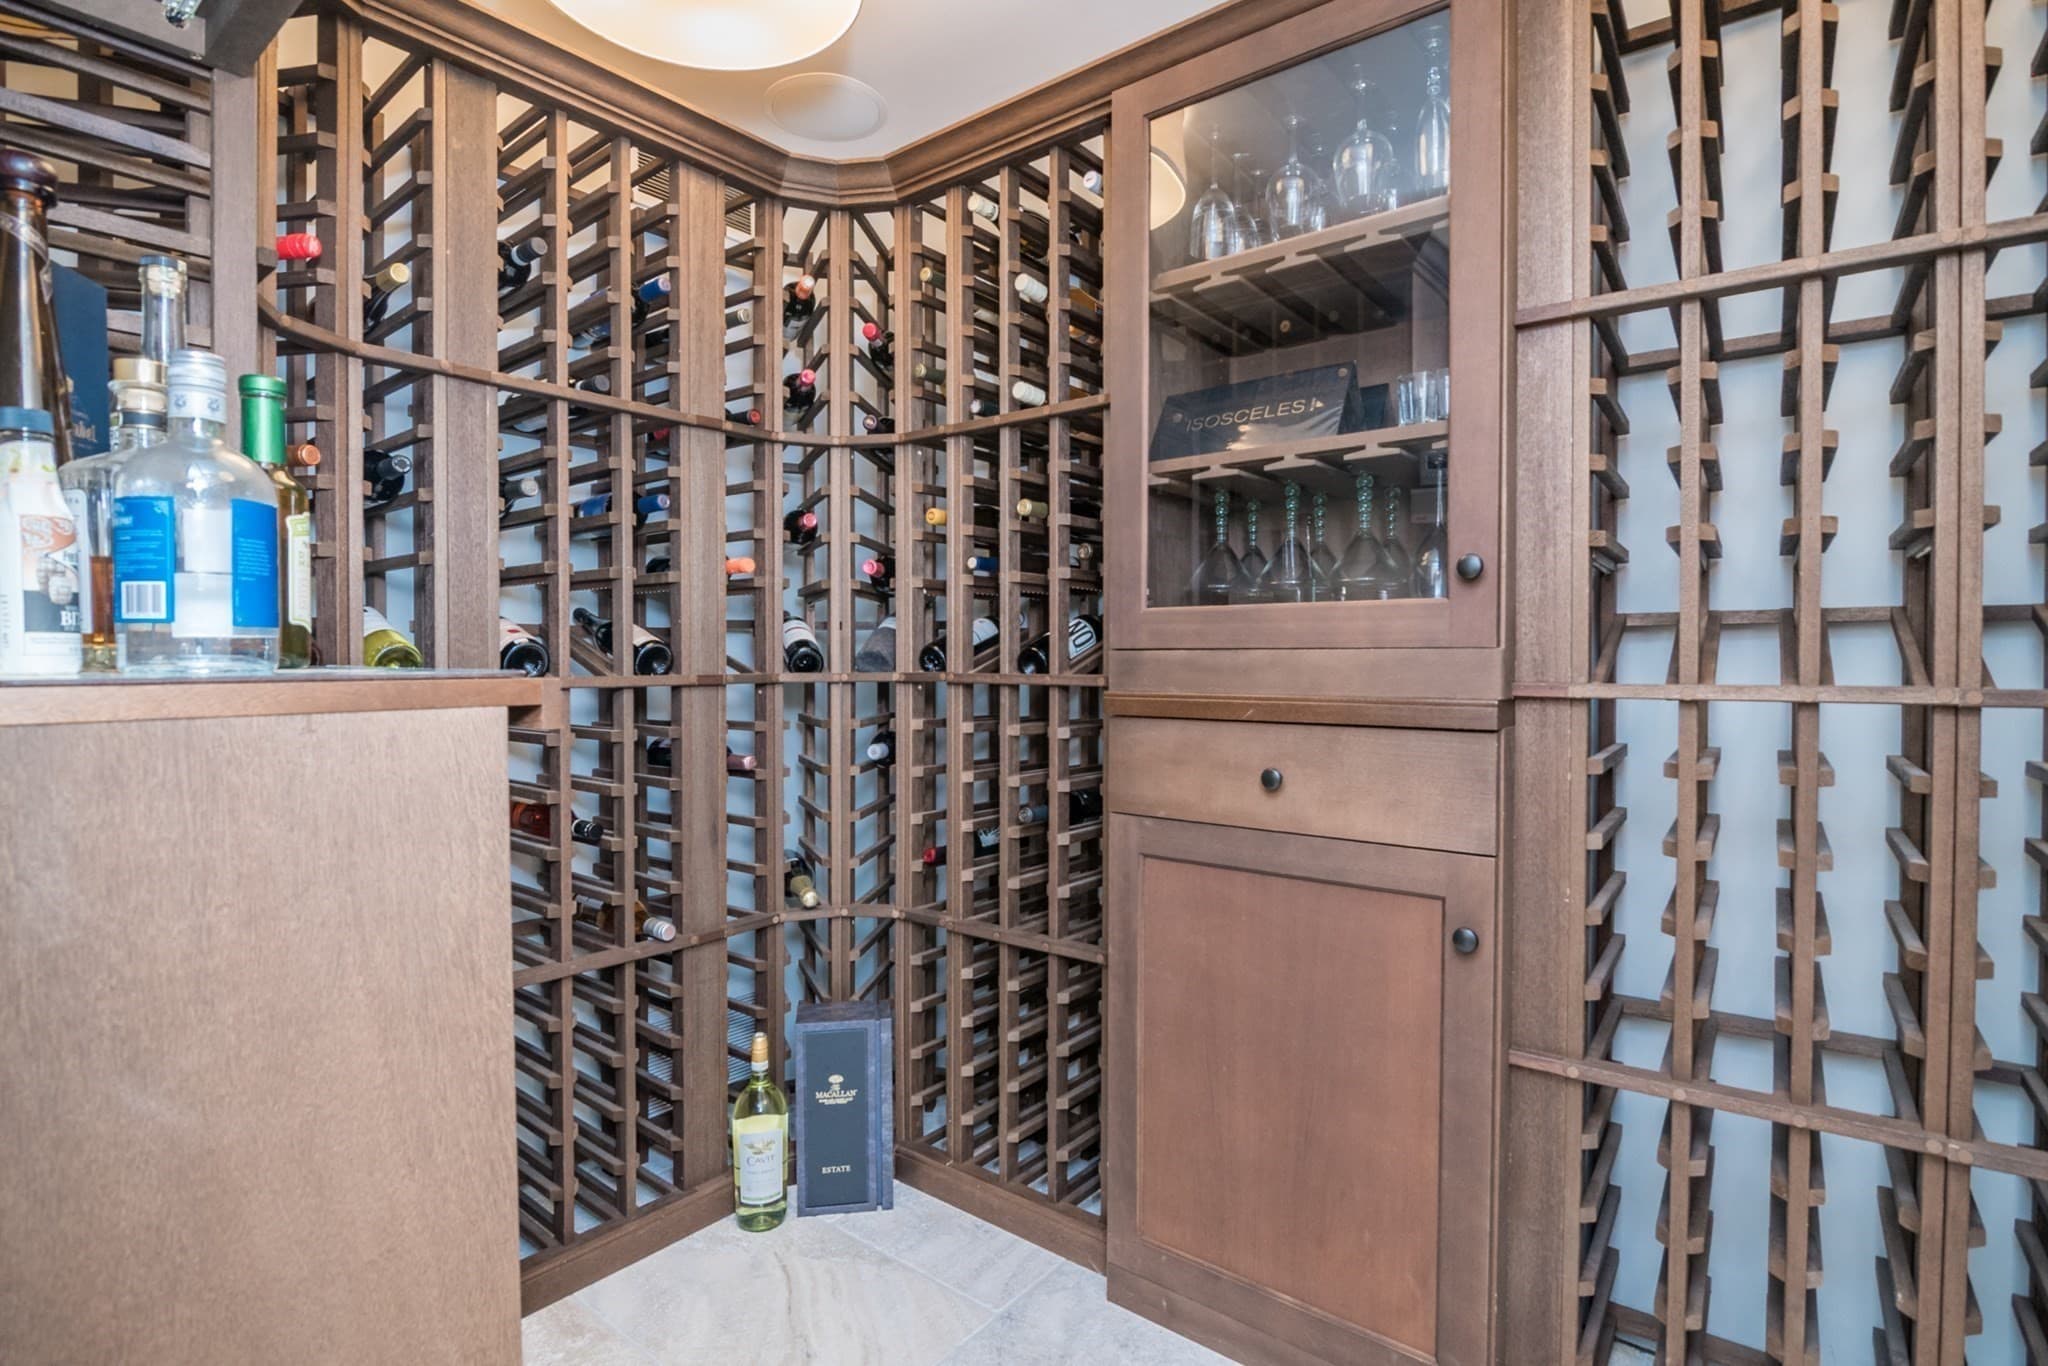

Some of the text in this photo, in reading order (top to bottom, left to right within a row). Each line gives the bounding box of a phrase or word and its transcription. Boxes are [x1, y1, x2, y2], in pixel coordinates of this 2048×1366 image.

[1185, 399, 1306, 432] ISOSCELES
[815, 1089, 857, 1099] MACALLAN
[821, 1164, 851, 1174] ESTATE
